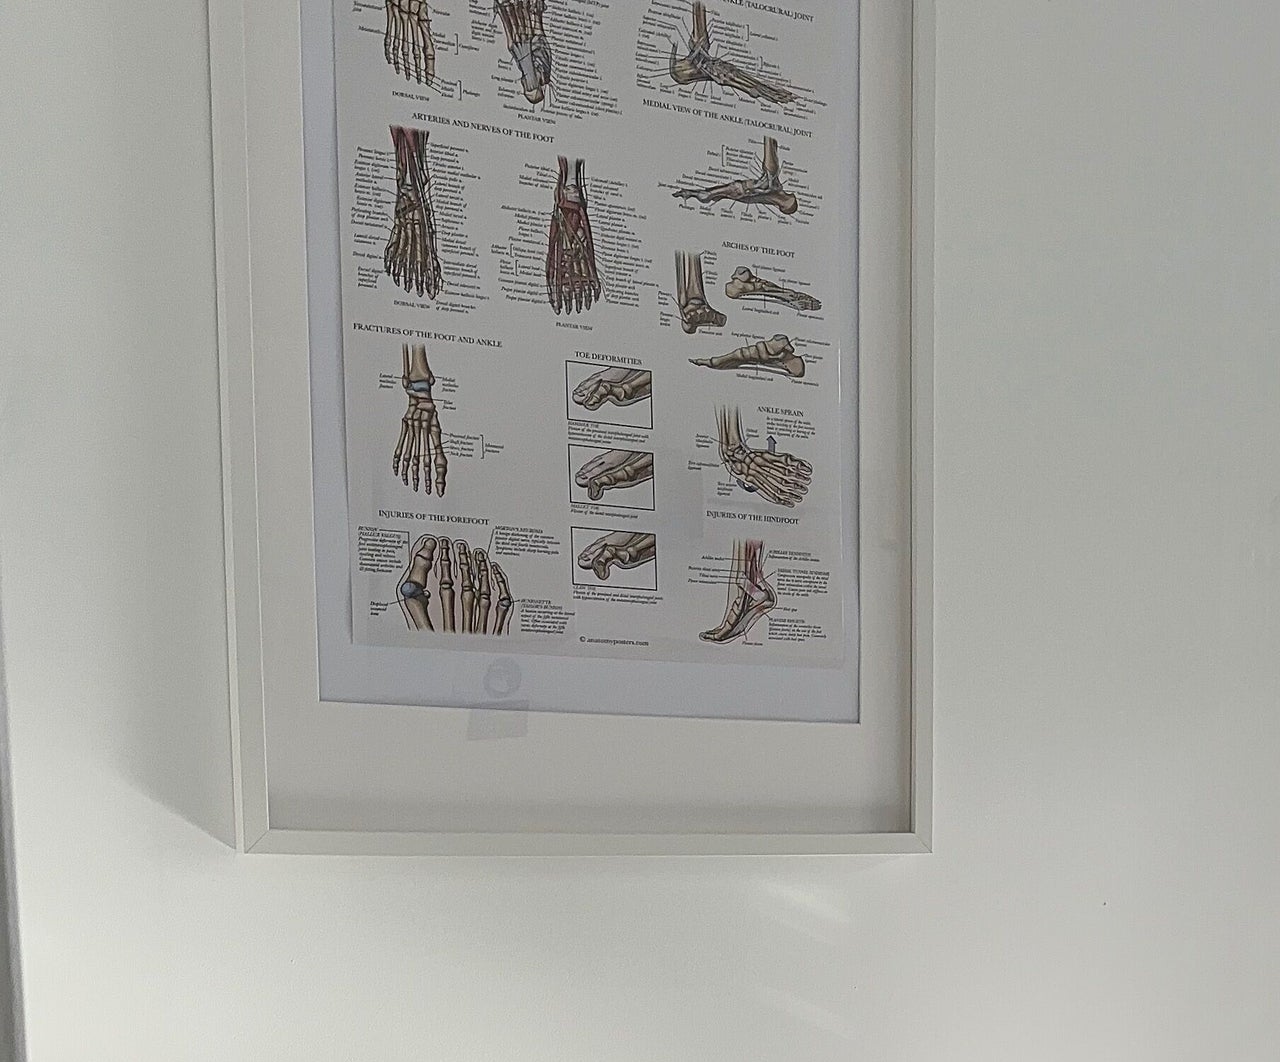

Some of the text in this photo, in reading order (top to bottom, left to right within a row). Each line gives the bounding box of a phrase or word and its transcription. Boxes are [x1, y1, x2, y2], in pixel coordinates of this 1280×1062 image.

[793, 11, 814, 22] JOINT
[643, 98, 671, 111] MEDIAL
[672, 104, 691, 114] VIEW
[703, 111, 719, 120] THE
[720, 114, 743, 125] ANKLE
[793, 128, 813, 138] JOINT
[412, 112, 554, 143] ARTERIES AND NERVES OF THE FOOT
[721, 241, 749, 252] ARCHES
[761, 246, 776, 255] THE
[776, 249, 795, 259] FOOT
[353, 322, 503, 348] FRACTURES OF THE FOOT AND ANKLE
[575, 350, 643, 366] TOE DEFORMITIES
[757, 406, 804, 417] ANKLE SPRAIN
[378, 509, 490, 525] INJURIES OF THE FOREFOOT
[706, 510, 799, 525] INJURIES OF THE HINDFOOT
[587, 637, 649, 647] anatomyposters.com
